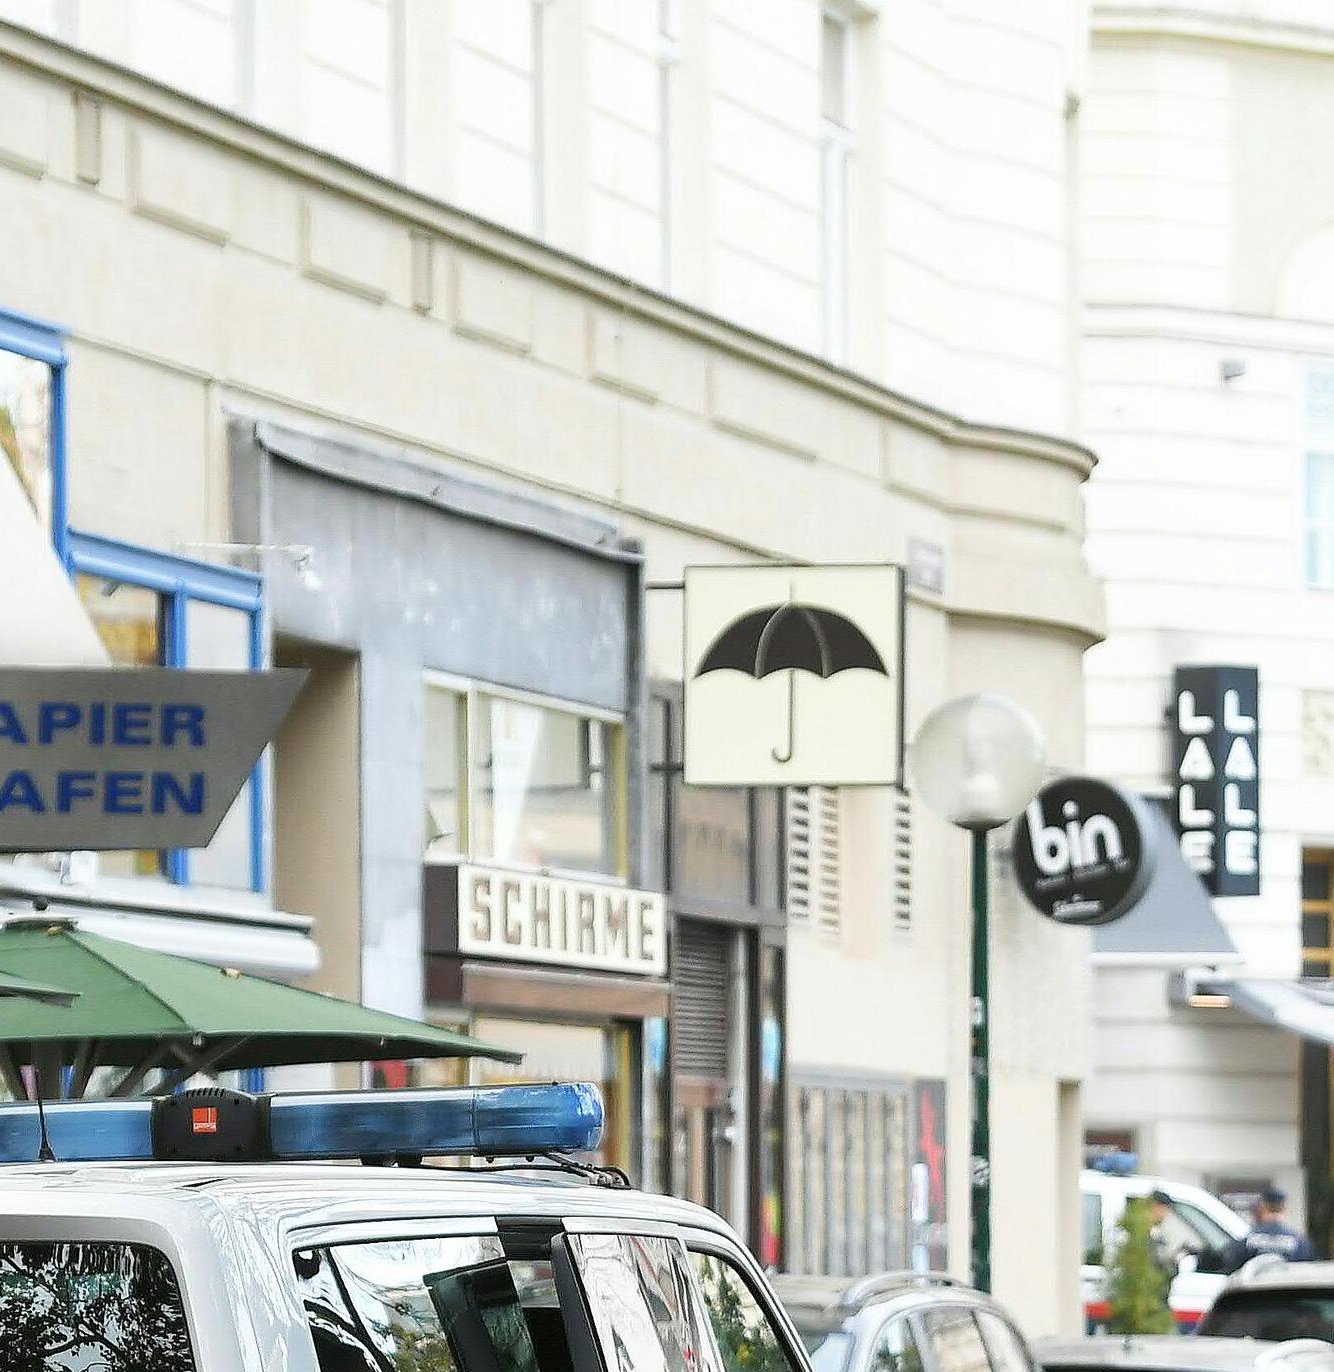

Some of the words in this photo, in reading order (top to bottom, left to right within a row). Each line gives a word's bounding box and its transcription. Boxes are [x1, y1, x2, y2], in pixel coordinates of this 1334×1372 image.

[1027, 798, 1125, 875] bin
[1178, 689, 1216, 875] LALE
[1223, 688, 1259, 876] LALE
[471, 876, 657, 962] SCHIRME
